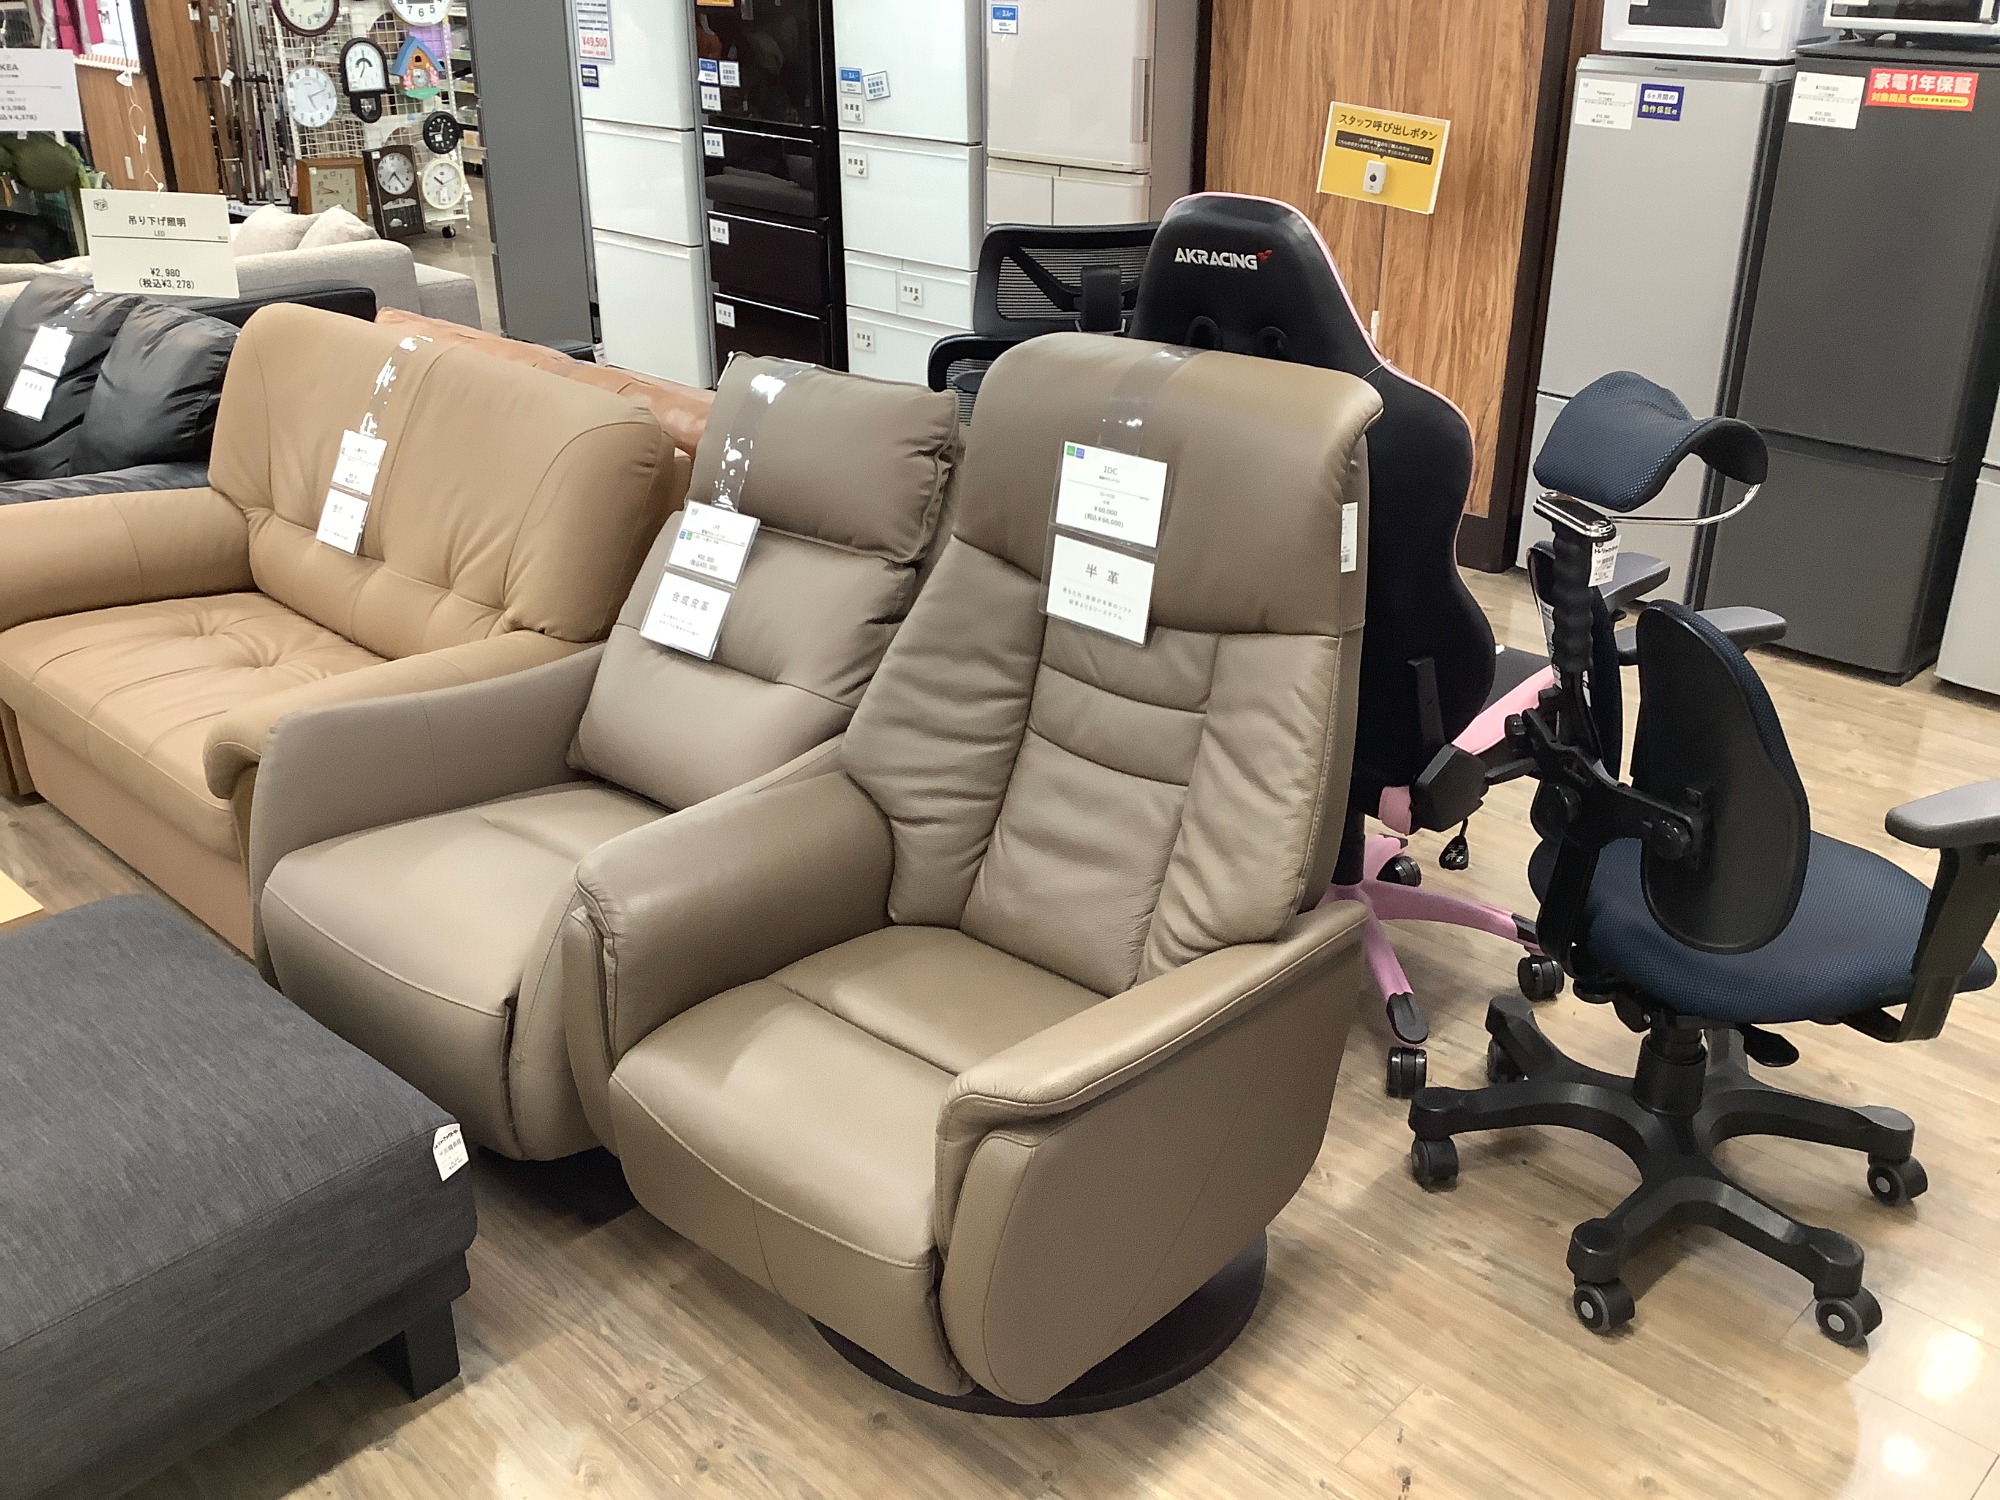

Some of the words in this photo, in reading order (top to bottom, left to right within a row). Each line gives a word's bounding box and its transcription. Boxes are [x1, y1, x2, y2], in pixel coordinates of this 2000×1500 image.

[1873, 72, 1973, 95] 家電1年保証
[1338, 114, 1438, 141] スタッフ呼び出しボタン
[128, 215, 187, 228] 吊り下げ照明
[1174, 247, 1258, 271] AKRACING
[1103, 465, 1119, 476] IDC
